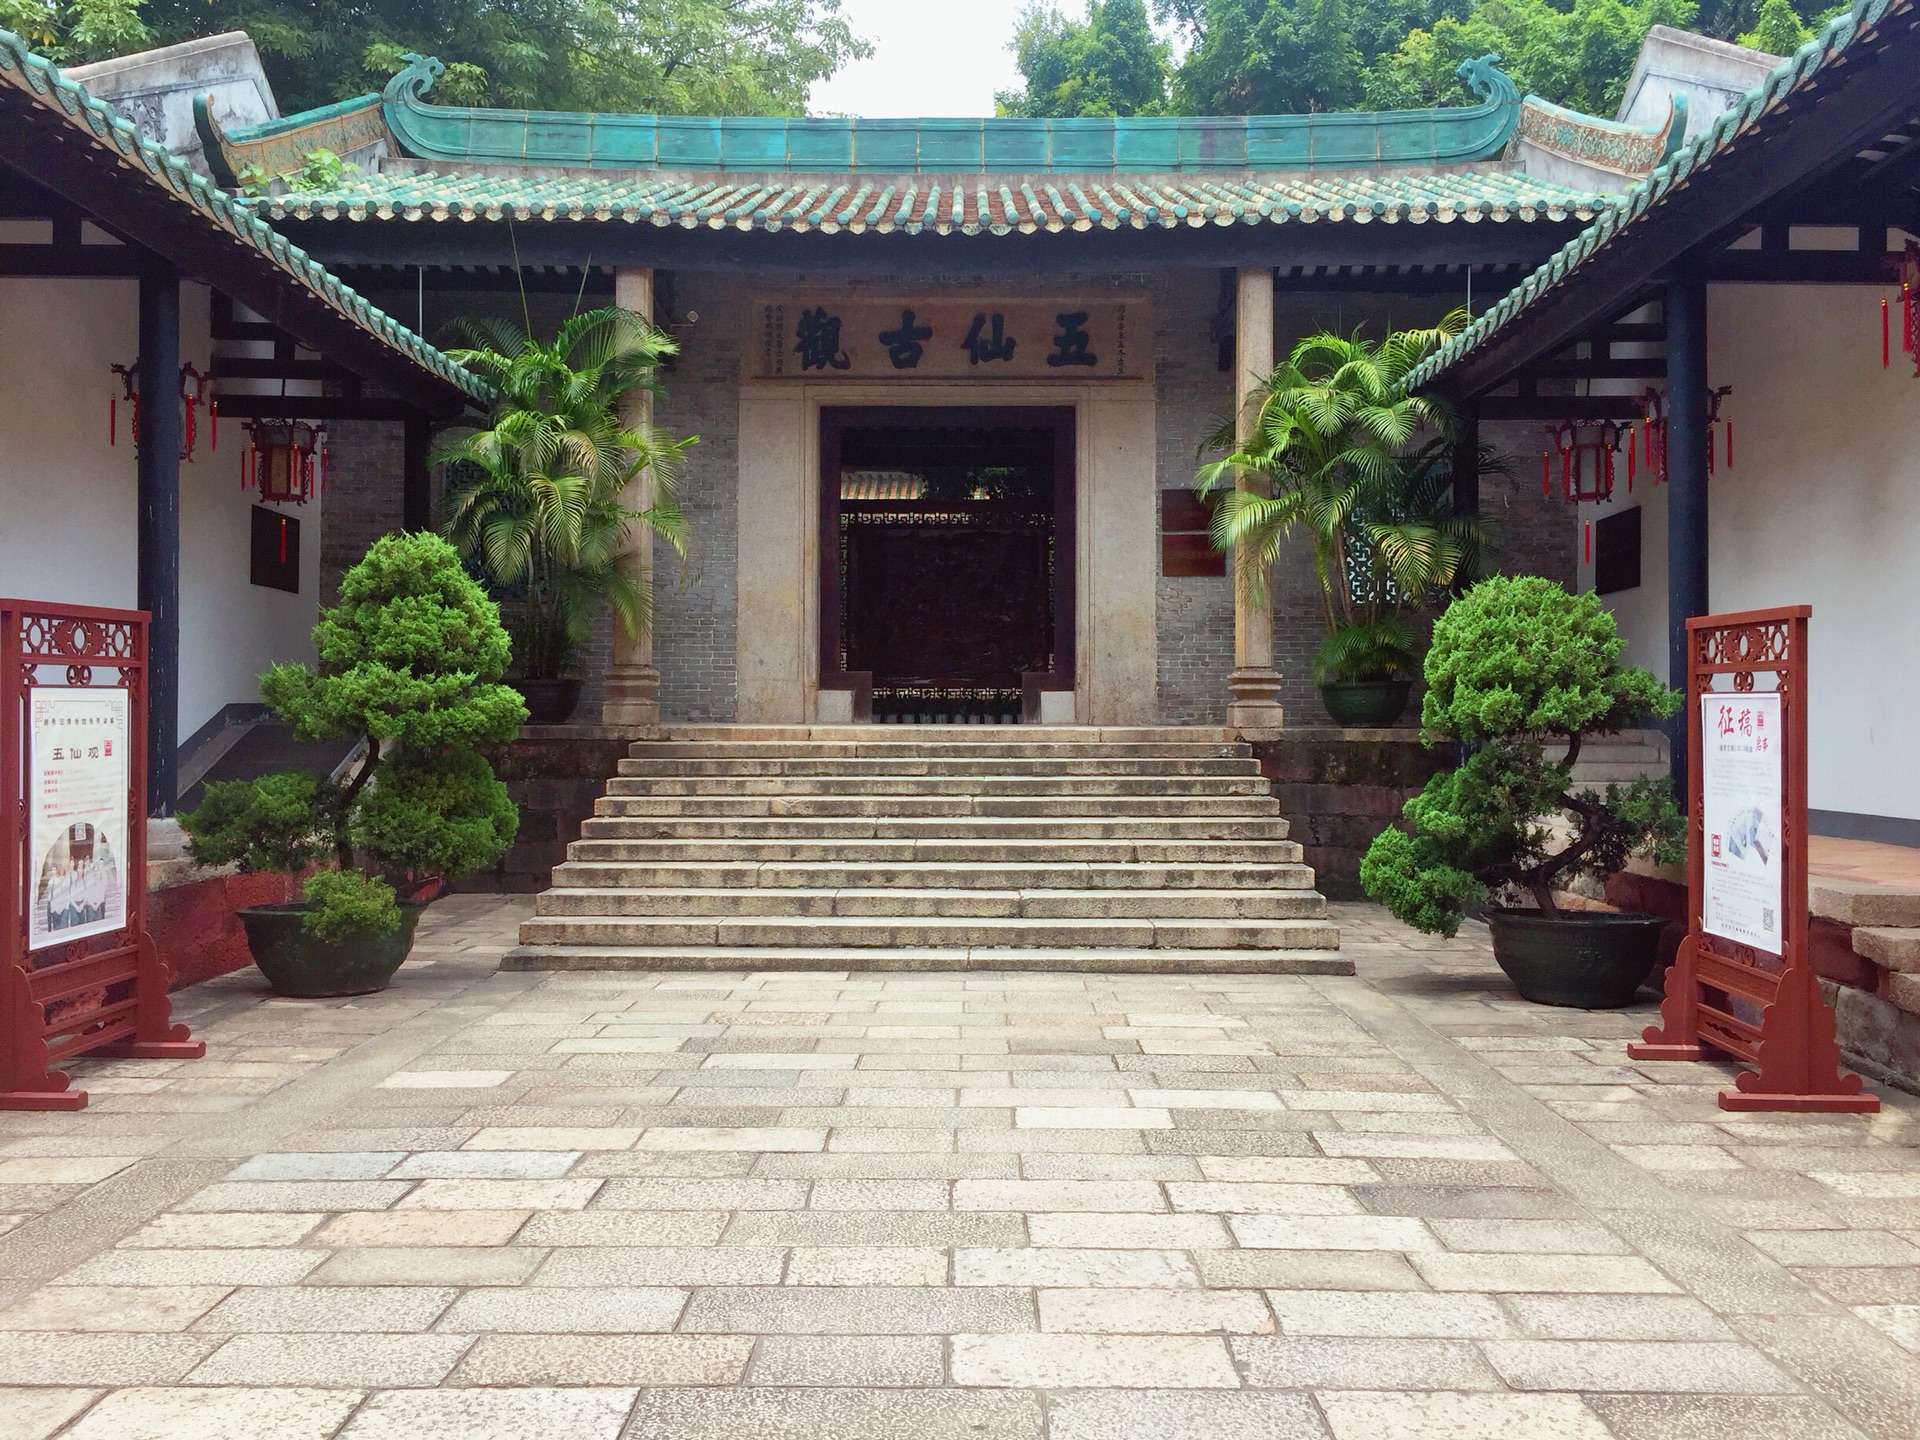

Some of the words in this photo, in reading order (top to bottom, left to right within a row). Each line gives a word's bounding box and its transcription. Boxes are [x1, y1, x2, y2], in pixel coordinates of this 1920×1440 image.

[793, 306, 1099, 371] 五仙古觀
[1717, 704, 1753, 739] 征稿
[52, 746, 99, 760] 五仙观
